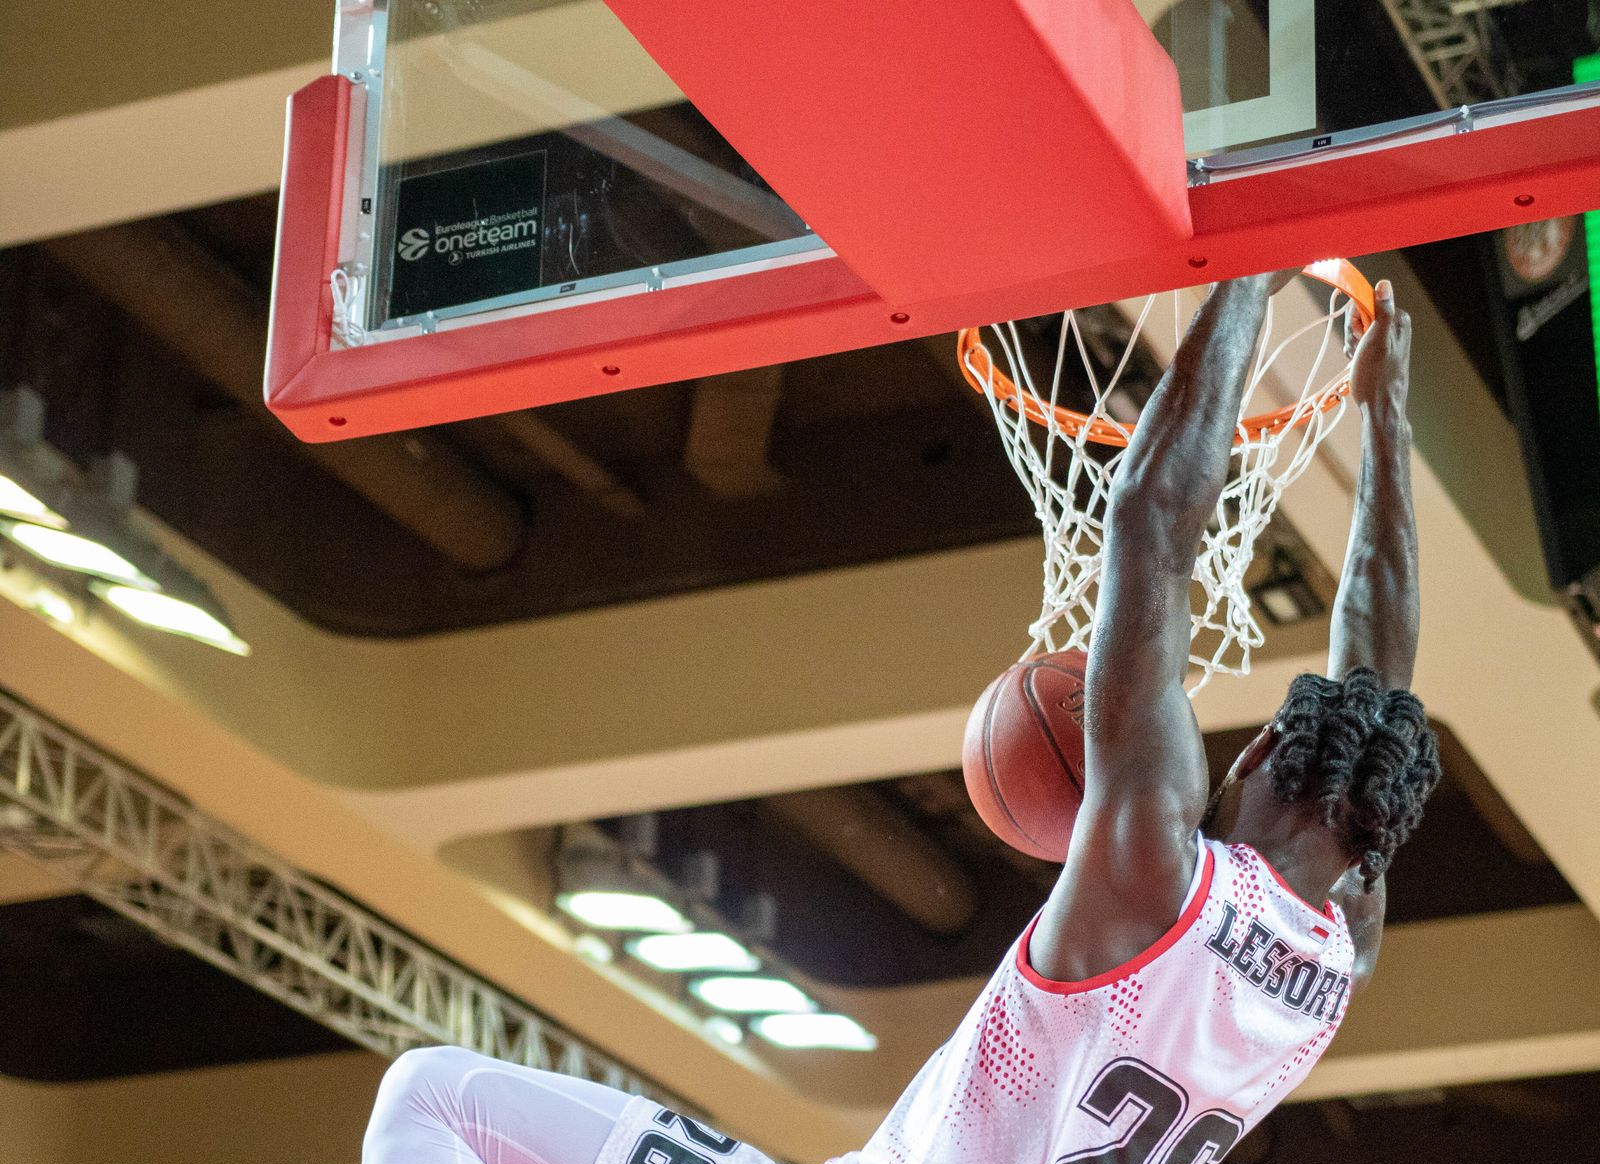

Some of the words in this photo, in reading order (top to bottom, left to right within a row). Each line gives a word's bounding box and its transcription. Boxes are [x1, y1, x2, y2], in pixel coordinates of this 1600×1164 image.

[435, 217, 490, 235] Euroleague
[490, 206, 538, 226] Basketball
[435, 219, 537, 253] oneteam
[466, 245, 500, 259] TURKISH
[501, 239, 536, 252] AIRLINES
